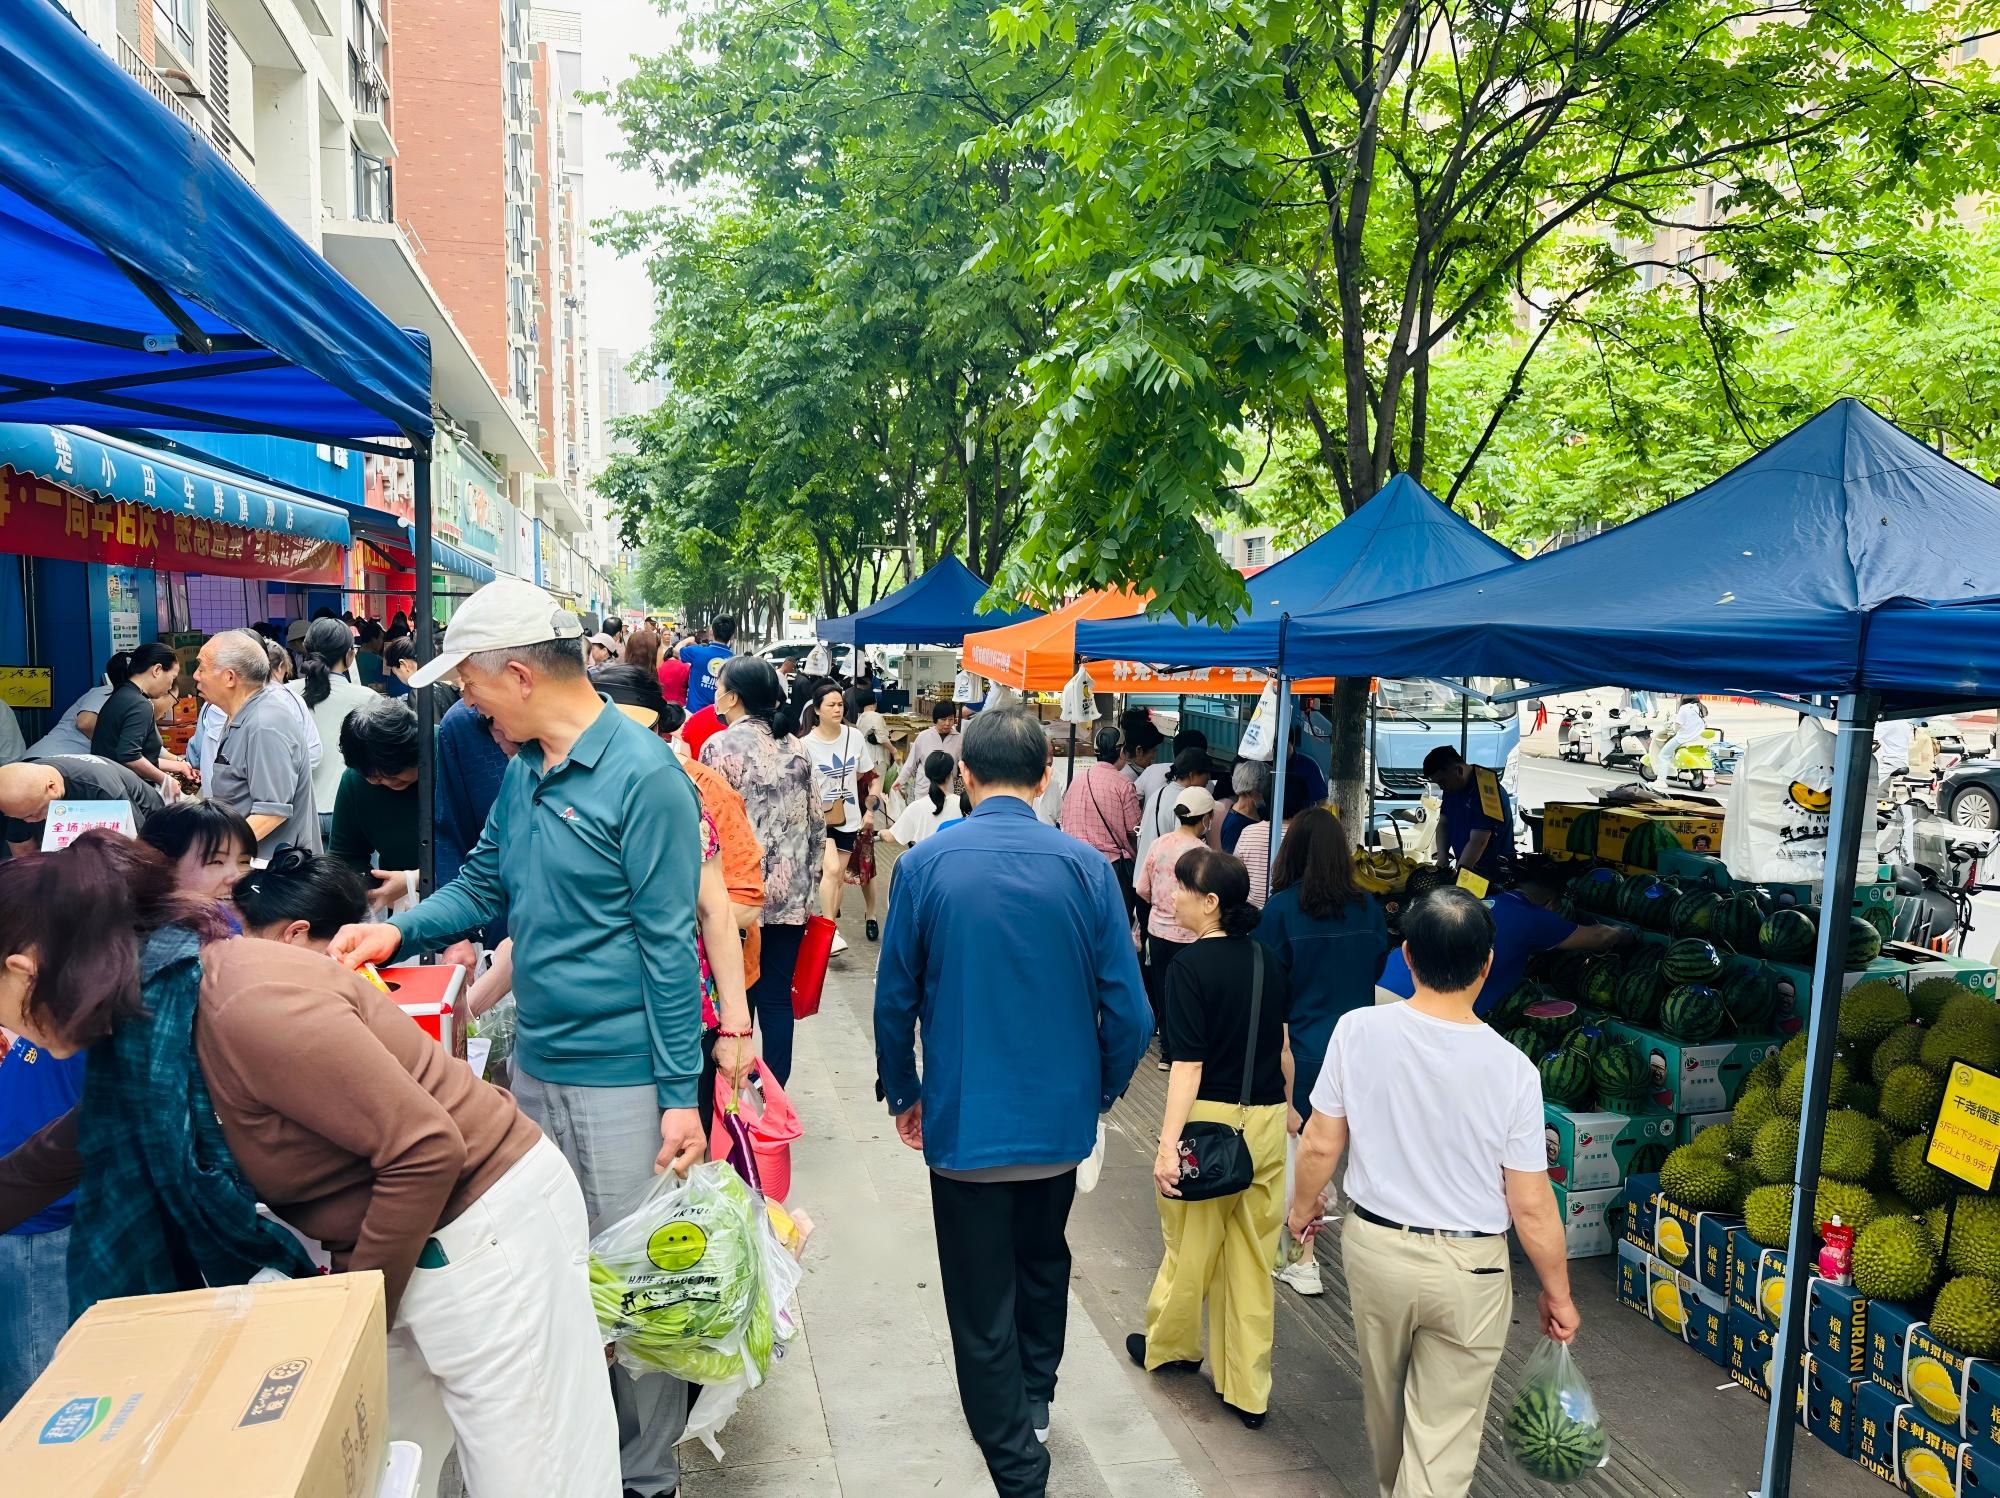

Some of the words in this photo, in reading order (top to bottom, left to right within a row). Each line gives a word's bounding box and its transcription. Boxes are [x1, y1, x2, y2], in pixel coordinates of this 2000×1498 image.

[1731, 1335, 1743, 1368] 精品
[1829, 1315, 1841, 1352] 榴莲
[1850, 1300, 1867, 1372] DURIAN
[1873, 1332, 1885, 1370] 精品
[1731, 1369, 1767, 1399] DURIAN
[1829, 1396, 1842, 1434] 榴莲
[1861, 1417, 1876, 1455] 精品
